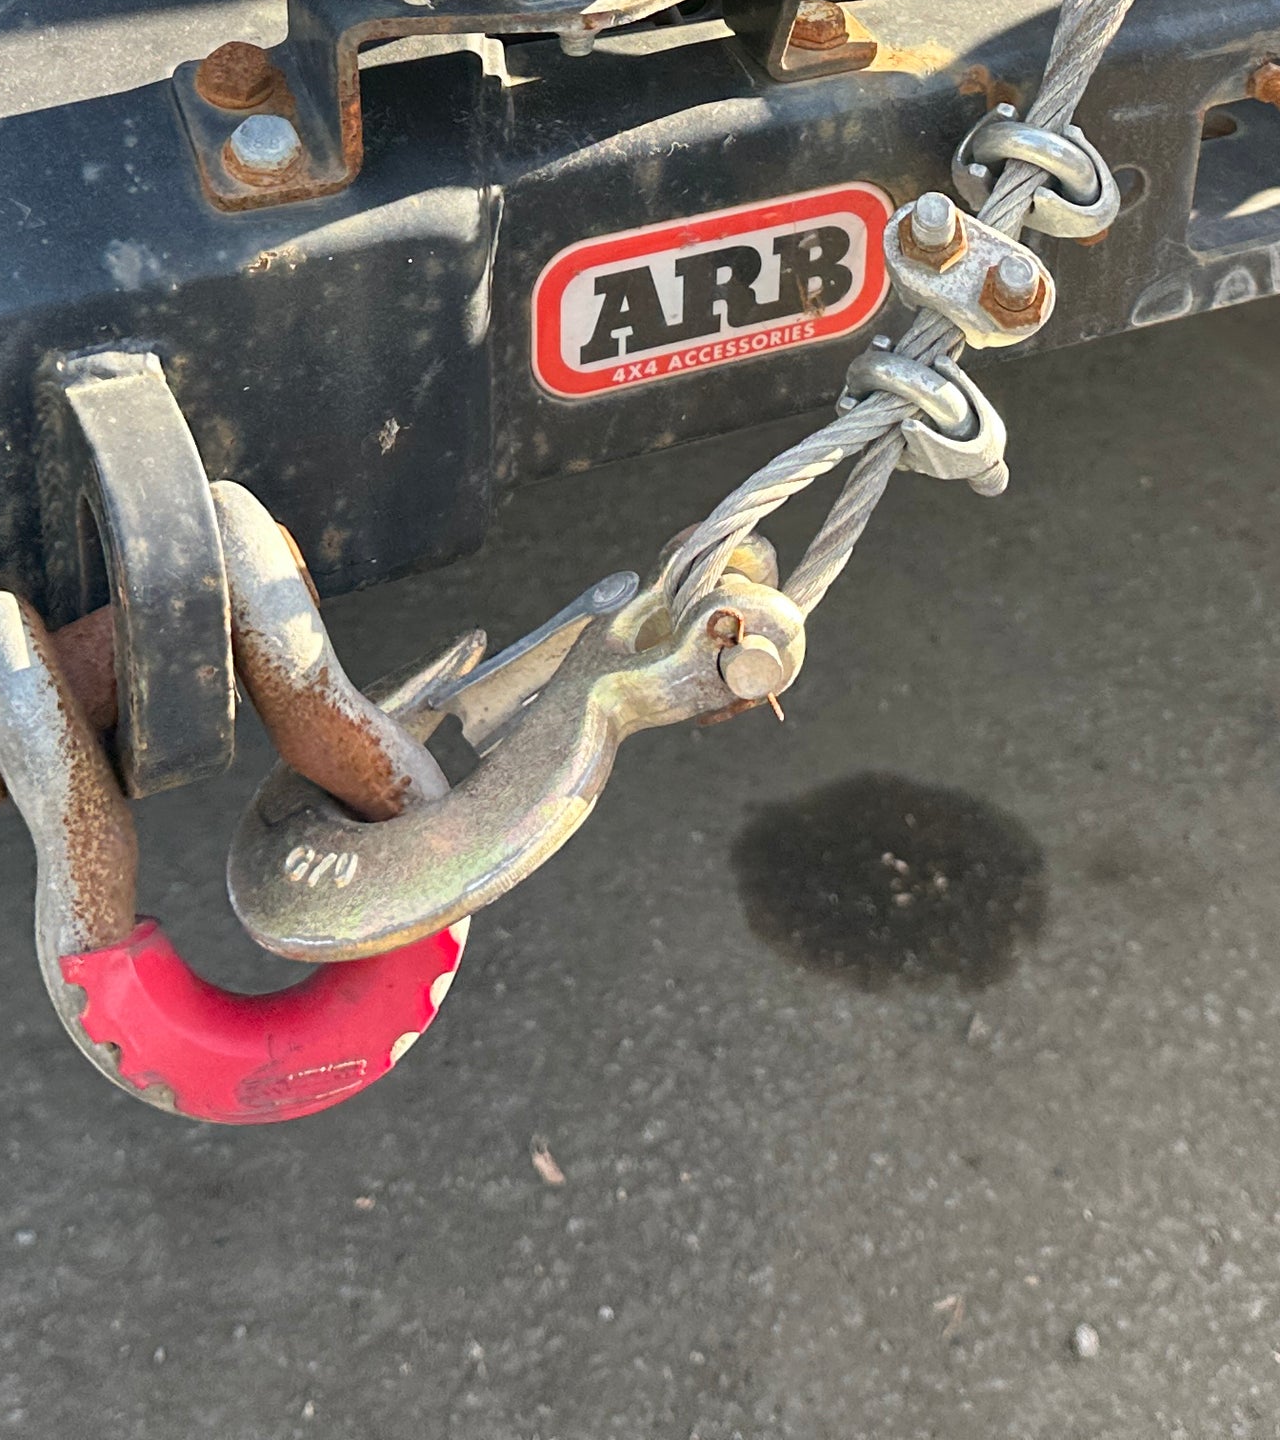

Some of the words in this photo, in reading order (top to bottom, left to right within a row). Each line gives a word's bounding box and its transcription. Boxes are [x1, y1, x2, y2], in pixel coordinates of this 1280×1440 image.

[580, 226, 853, 365] ARB
[612, 360, 658, 383] 4X4
[668, 322, 817, 371] ACCESSORIES
